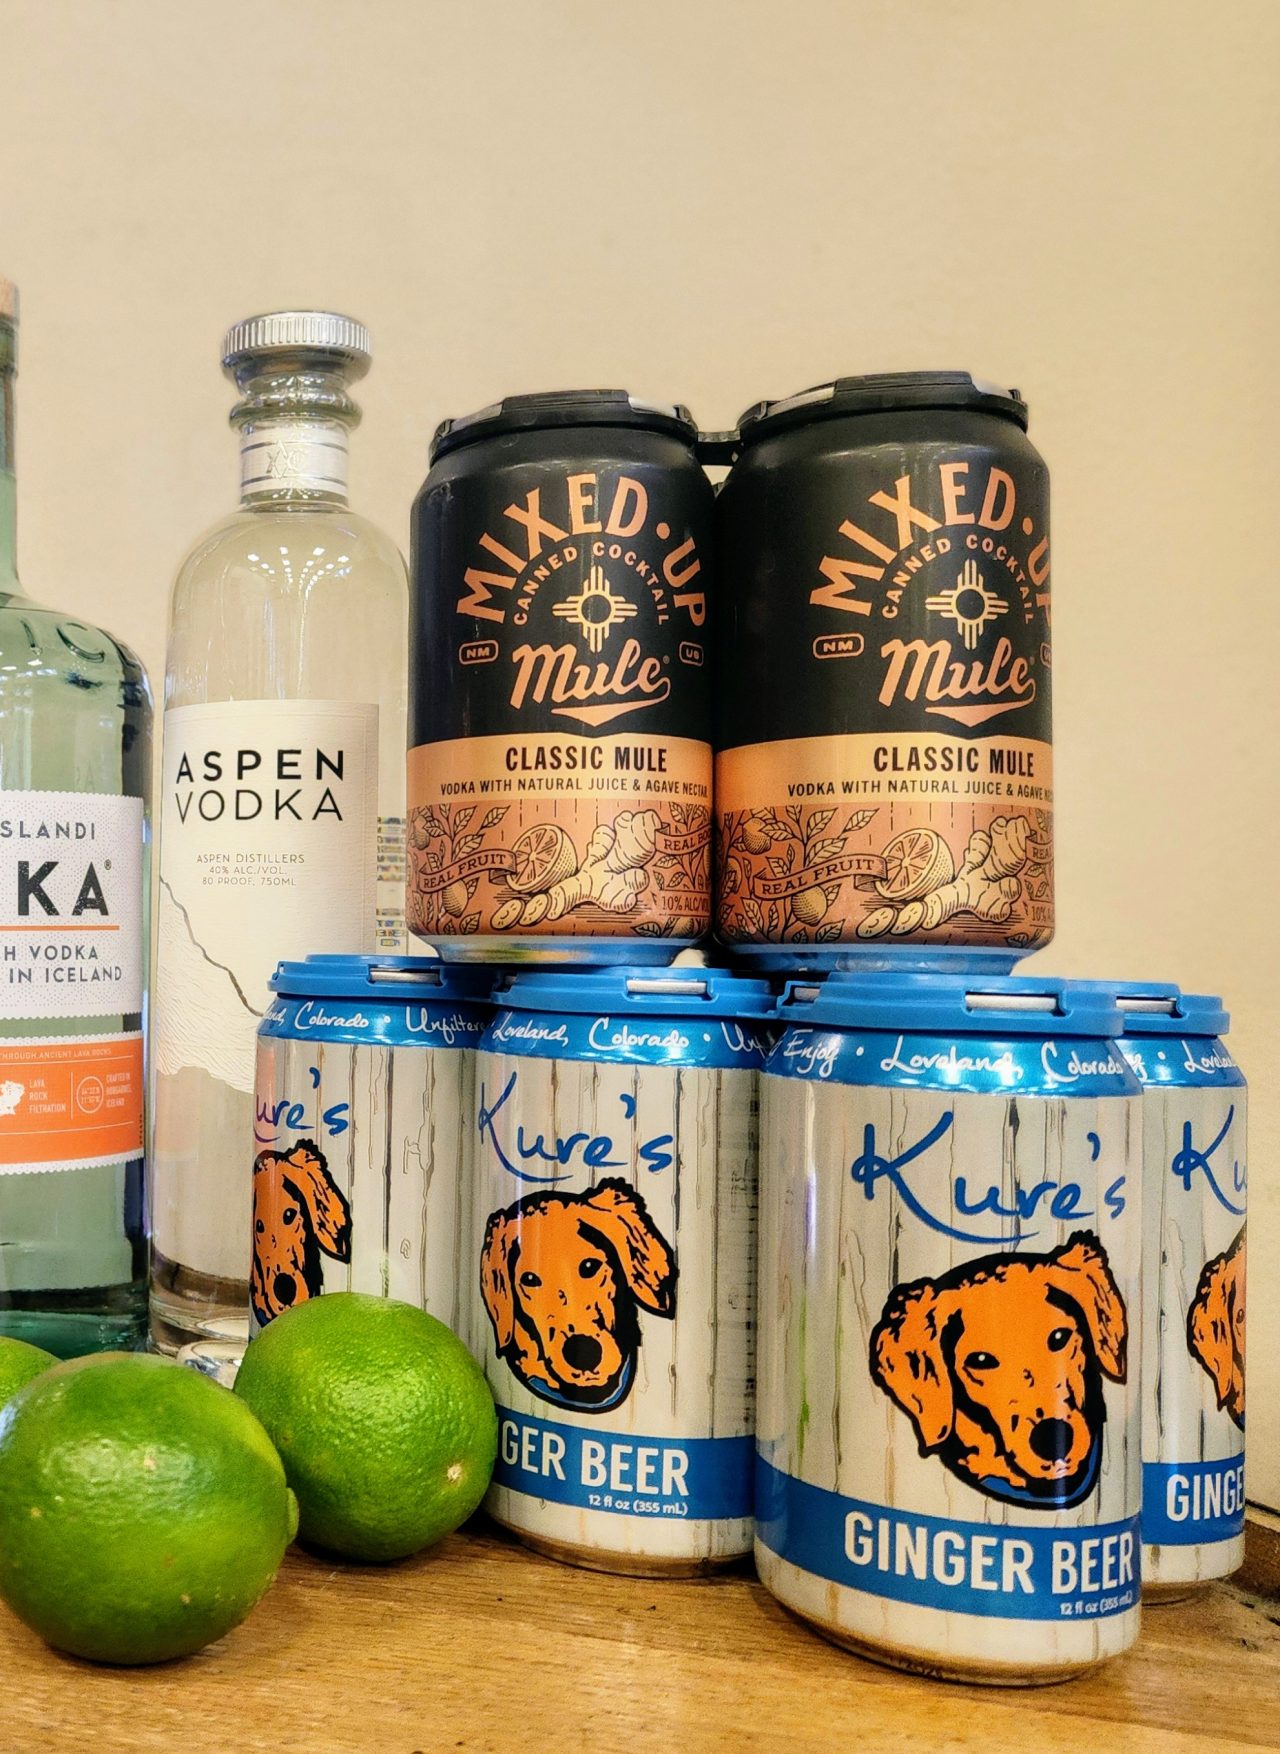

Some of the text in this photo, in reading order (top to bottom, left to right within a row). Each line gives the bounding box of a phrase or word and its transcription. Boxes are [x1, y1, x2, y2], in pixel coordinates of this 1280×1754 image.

[513, 541, 670, 625] CANNED COCKTAIL
[882, 534, 1035, 624] CANNED COCKTAIL
[466, 647, 490, 659] NM
[823, 640, 854, 652] NM
[509, 638, 671, 710] Mule
[878, 637, 1037, 708] Mule
[176, 748, 344, 784] ASPEN
[505, 745, 667, 773] CLASSIC MULE
[873, 746, 1035, 777] CLASSIC MULE
[440, 782, 475, 796] VODKA
[480, 780, 512, 793] WITH
[517, 778, 582, 791] NATURAL
[588, 777, 628, 791] JUICE
[632, 779, 641, 791] &
[645, 780, 680, 794] AGAVE
[787, 781, 835, 797] VODKA
[842, 780, 881, 794] WITH
[888, 779, 958, 794] NATURAL
[964, 781, 1002, 796] JUICE
[1006, 783, 1014, 796] &
[1017, 783, 1043, 800] AGAVE
[175, 786, 343, 824] VODKA
[196, 853, 305, 864] ASPEN DISTILLERS
[663, 837, 696, 851] REAL
[202, 877, 214, 886] 80
[209, 866, 229, 875] 40%
[423, 853, 506, 888] REAL FRUIT
[762, 859, 875, 895] REAL FRUIT
[661, 895, 682, 912] 10%
[28, 945, 99, 961] VODKA
[8, 968, 33, 984] IN
[45, 966, 122, 983] ICELAND
[294, 1001, 369, 1030] Colorado
[492, 1011, 570, 1047] Loveland,
[588, 1017, 690, 1051] Colorado
[783, 1028, 840, 1078] Enjoy
[29, 1079, 45, 1089] LAVA
[29, 1091, 48, 1101] ROCK
[29, 1103, 66, 1113] FILTRATION
[254, 1066, 350, 1143] ure's
[478, 1071, 674, 1183] Kure's
[851, 1111, 1126, 1244] Kure's
[501, 1420, 689, 1498] GER BEER
[588, 1494, 689, 1516] 12 fl oz (355 mL)
[1166, 1465, 1243, 1522] GINGE
[843, 1510, 1134, 1595] GINGER BEER
